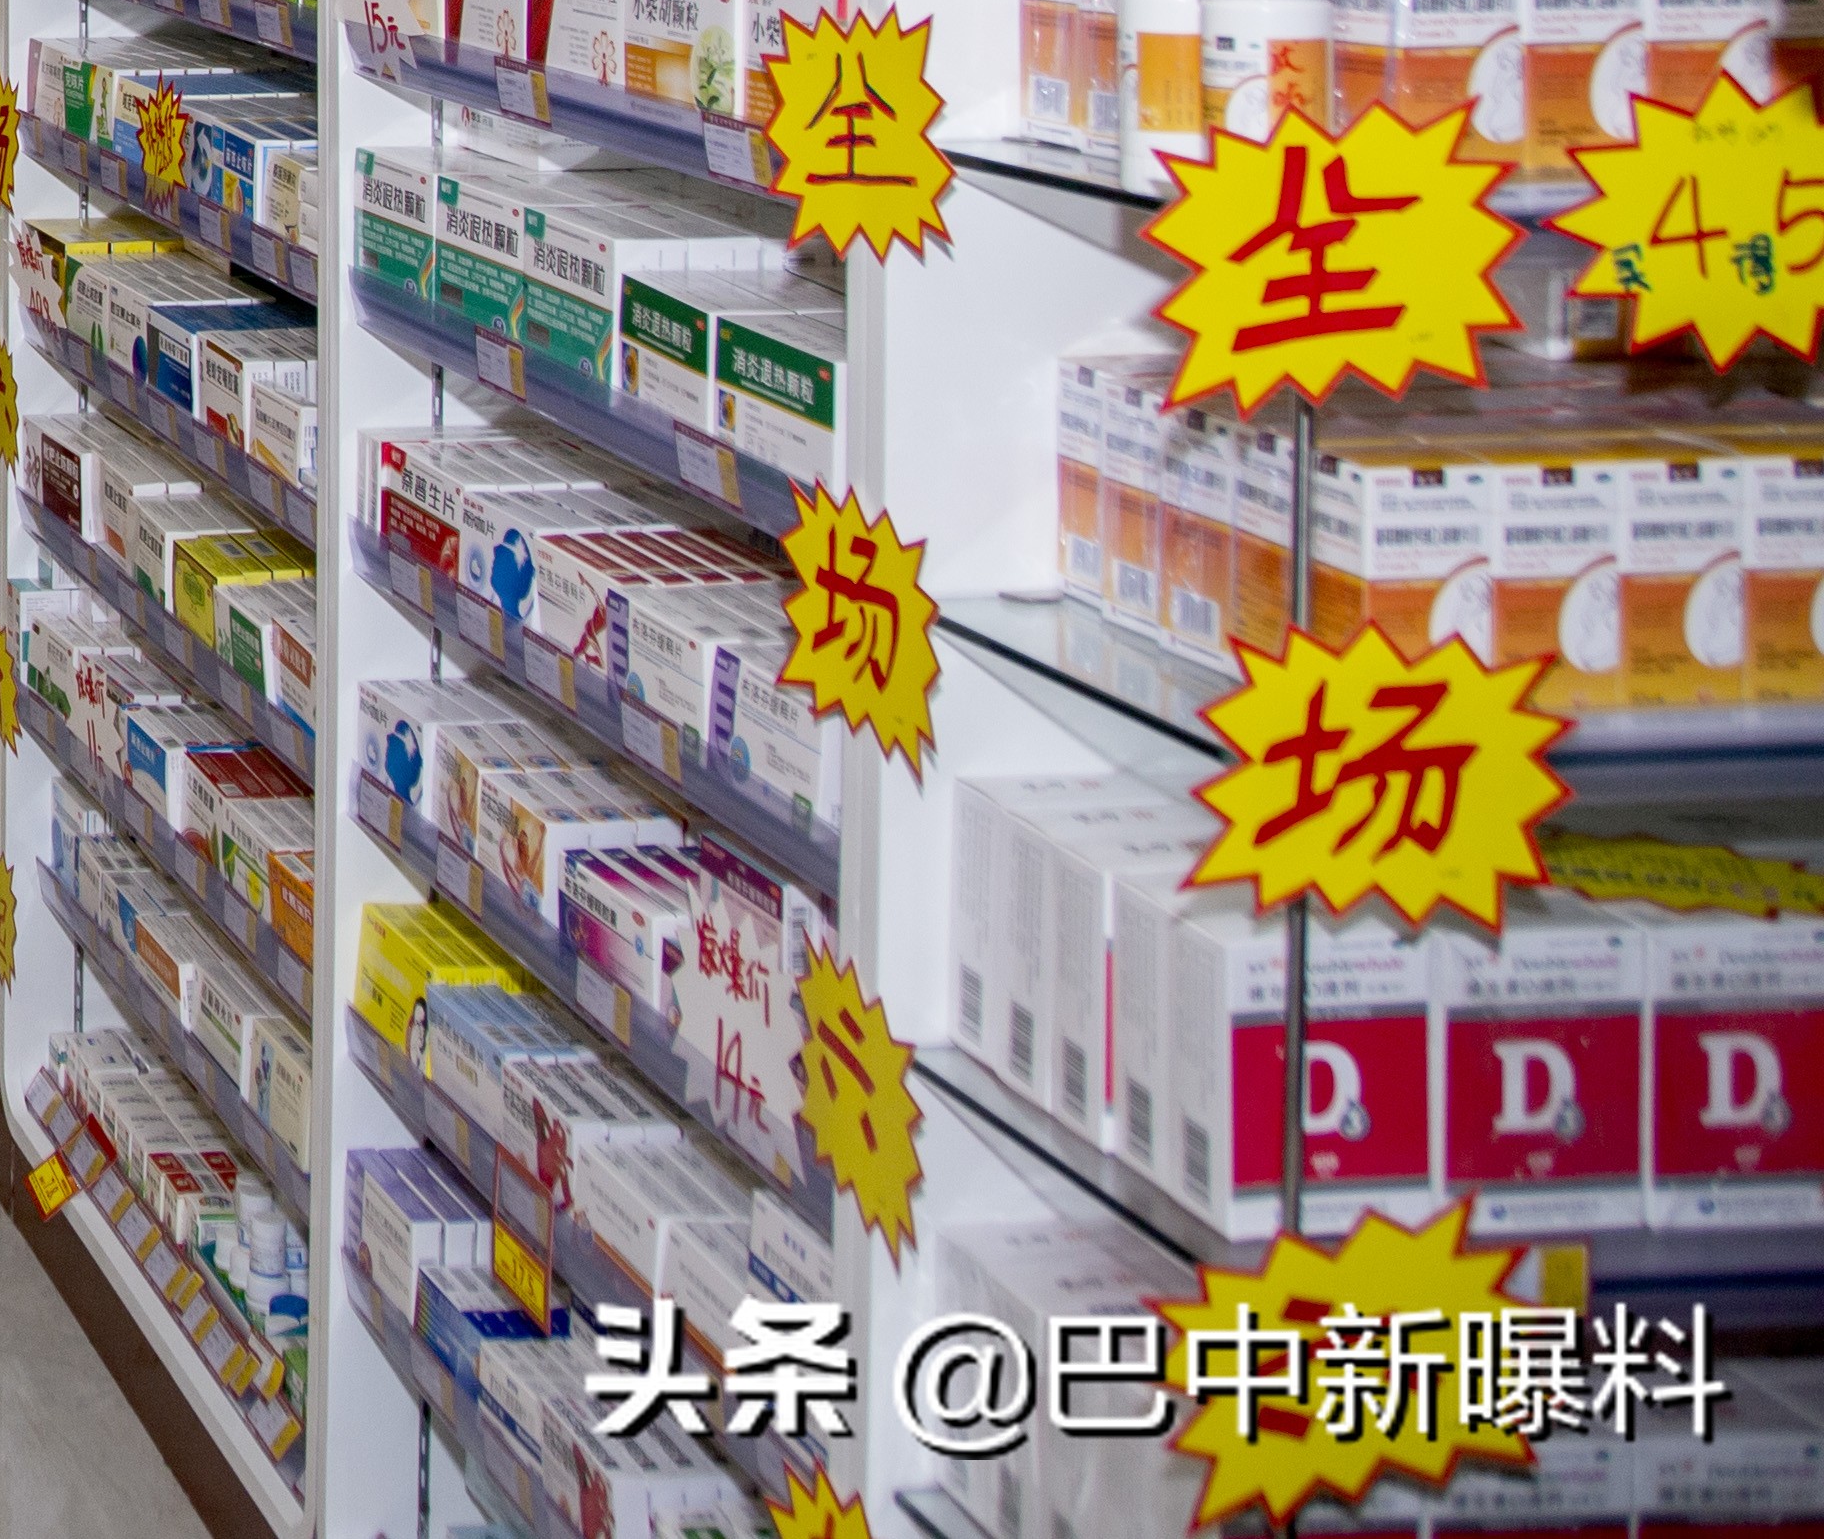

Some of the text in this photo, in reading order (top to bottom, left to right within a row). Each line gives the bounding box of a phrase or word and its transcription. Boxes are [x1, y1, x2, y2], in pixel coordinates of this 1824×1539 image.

[805, 52, 917, 187] 全
[362, 178, 428, 225] 消炎退热颗粒
[445, 211, 520, 259] 消炎退热颗粒
[1231, 147, 1420, 352] 全
[532, 241, 607, 296] 消炎退热颗粒
[631, 301, 693, 355] 消炎退热颗粒
[732, 348, 815, 407] 消炎退热颗粒
[811, 526, 899, 692] 场
[1253, 681, 1479, 858] 场
